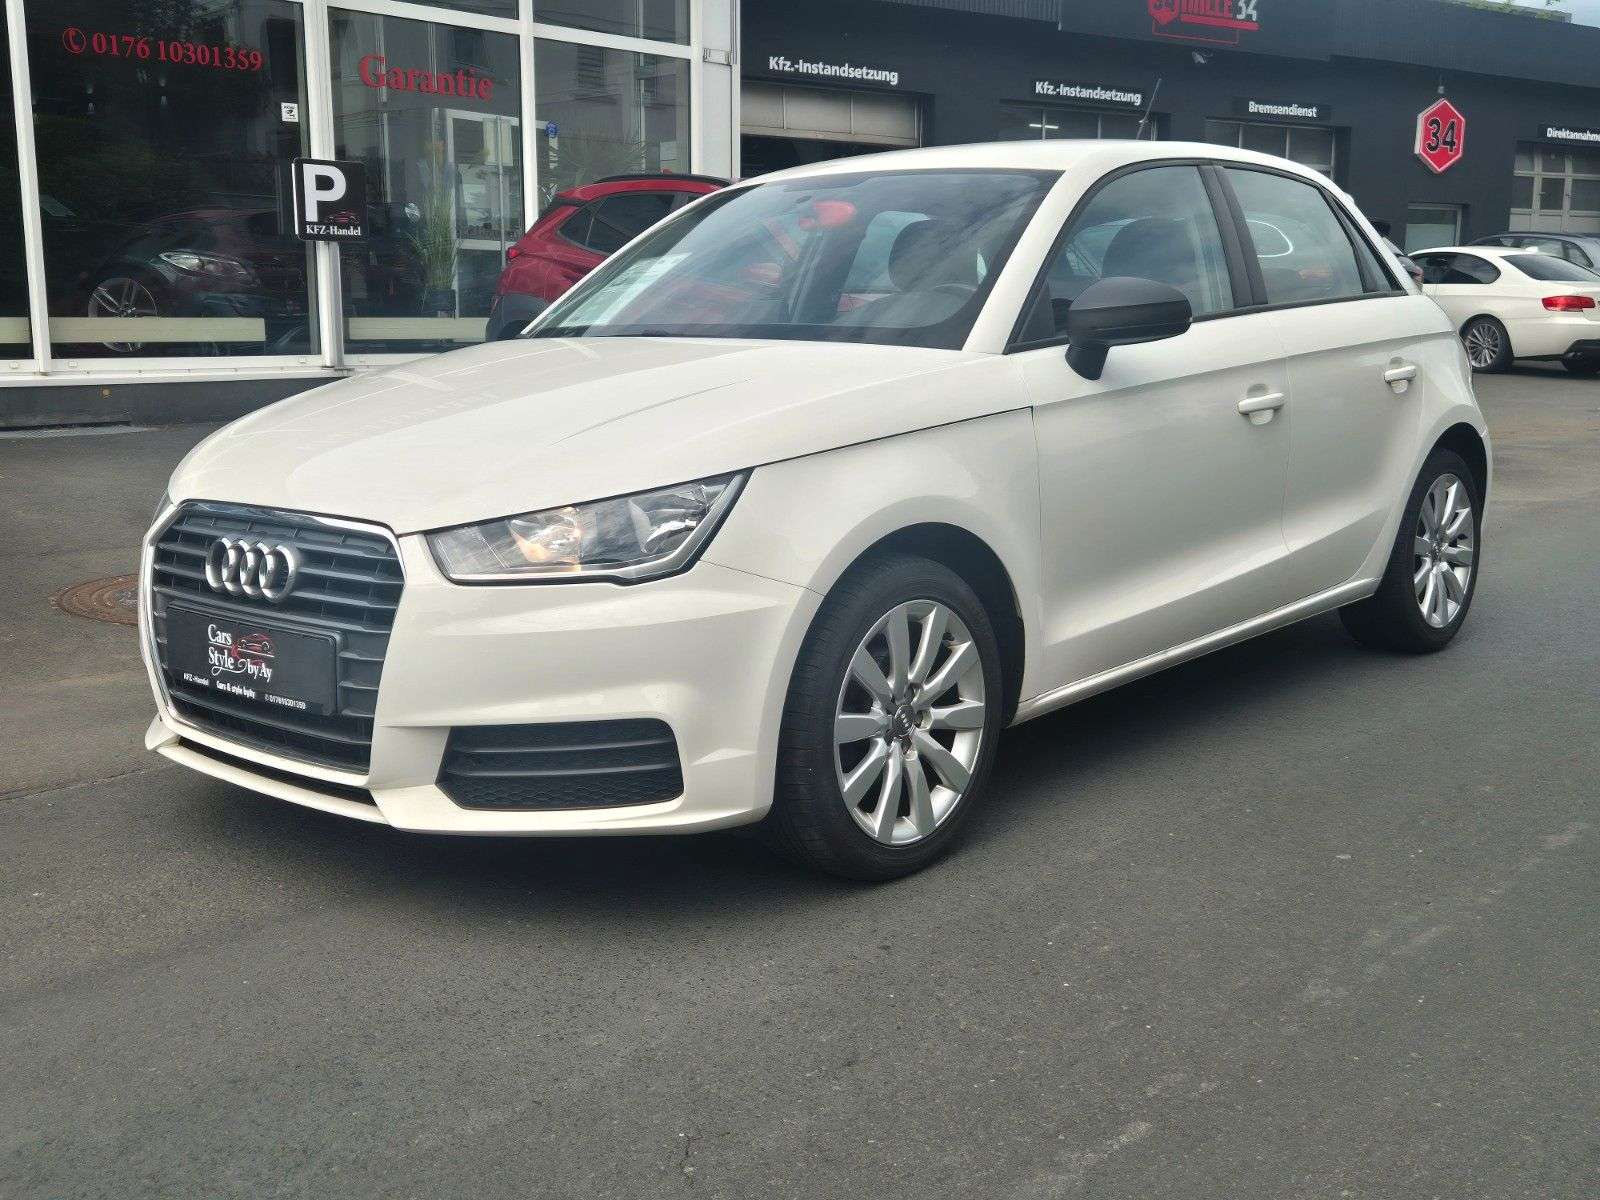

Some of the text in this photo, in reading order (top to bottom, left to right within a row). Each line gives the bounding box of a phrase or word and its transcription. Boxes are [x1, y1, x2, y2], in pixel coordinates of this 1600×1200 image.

[92, 32, 264, 71] 0176 10301359
[358, 54, 494, 102] Garantie
[768, 56, 899, 85] Kfz.-Instandsetzung
[1035, 81, 1142, 106] Kfz.-Instandsetzung
[1248, 101, 1318, 118] Bremsendienst
[1425, 118, 1457, 153] 34
[302, 163, 347, 222] P
[305, 225, 362, 236] KFZ-Handel
[207, 624, 232, 646] Cars
[208, 646, 273, 683] Style by Ay
